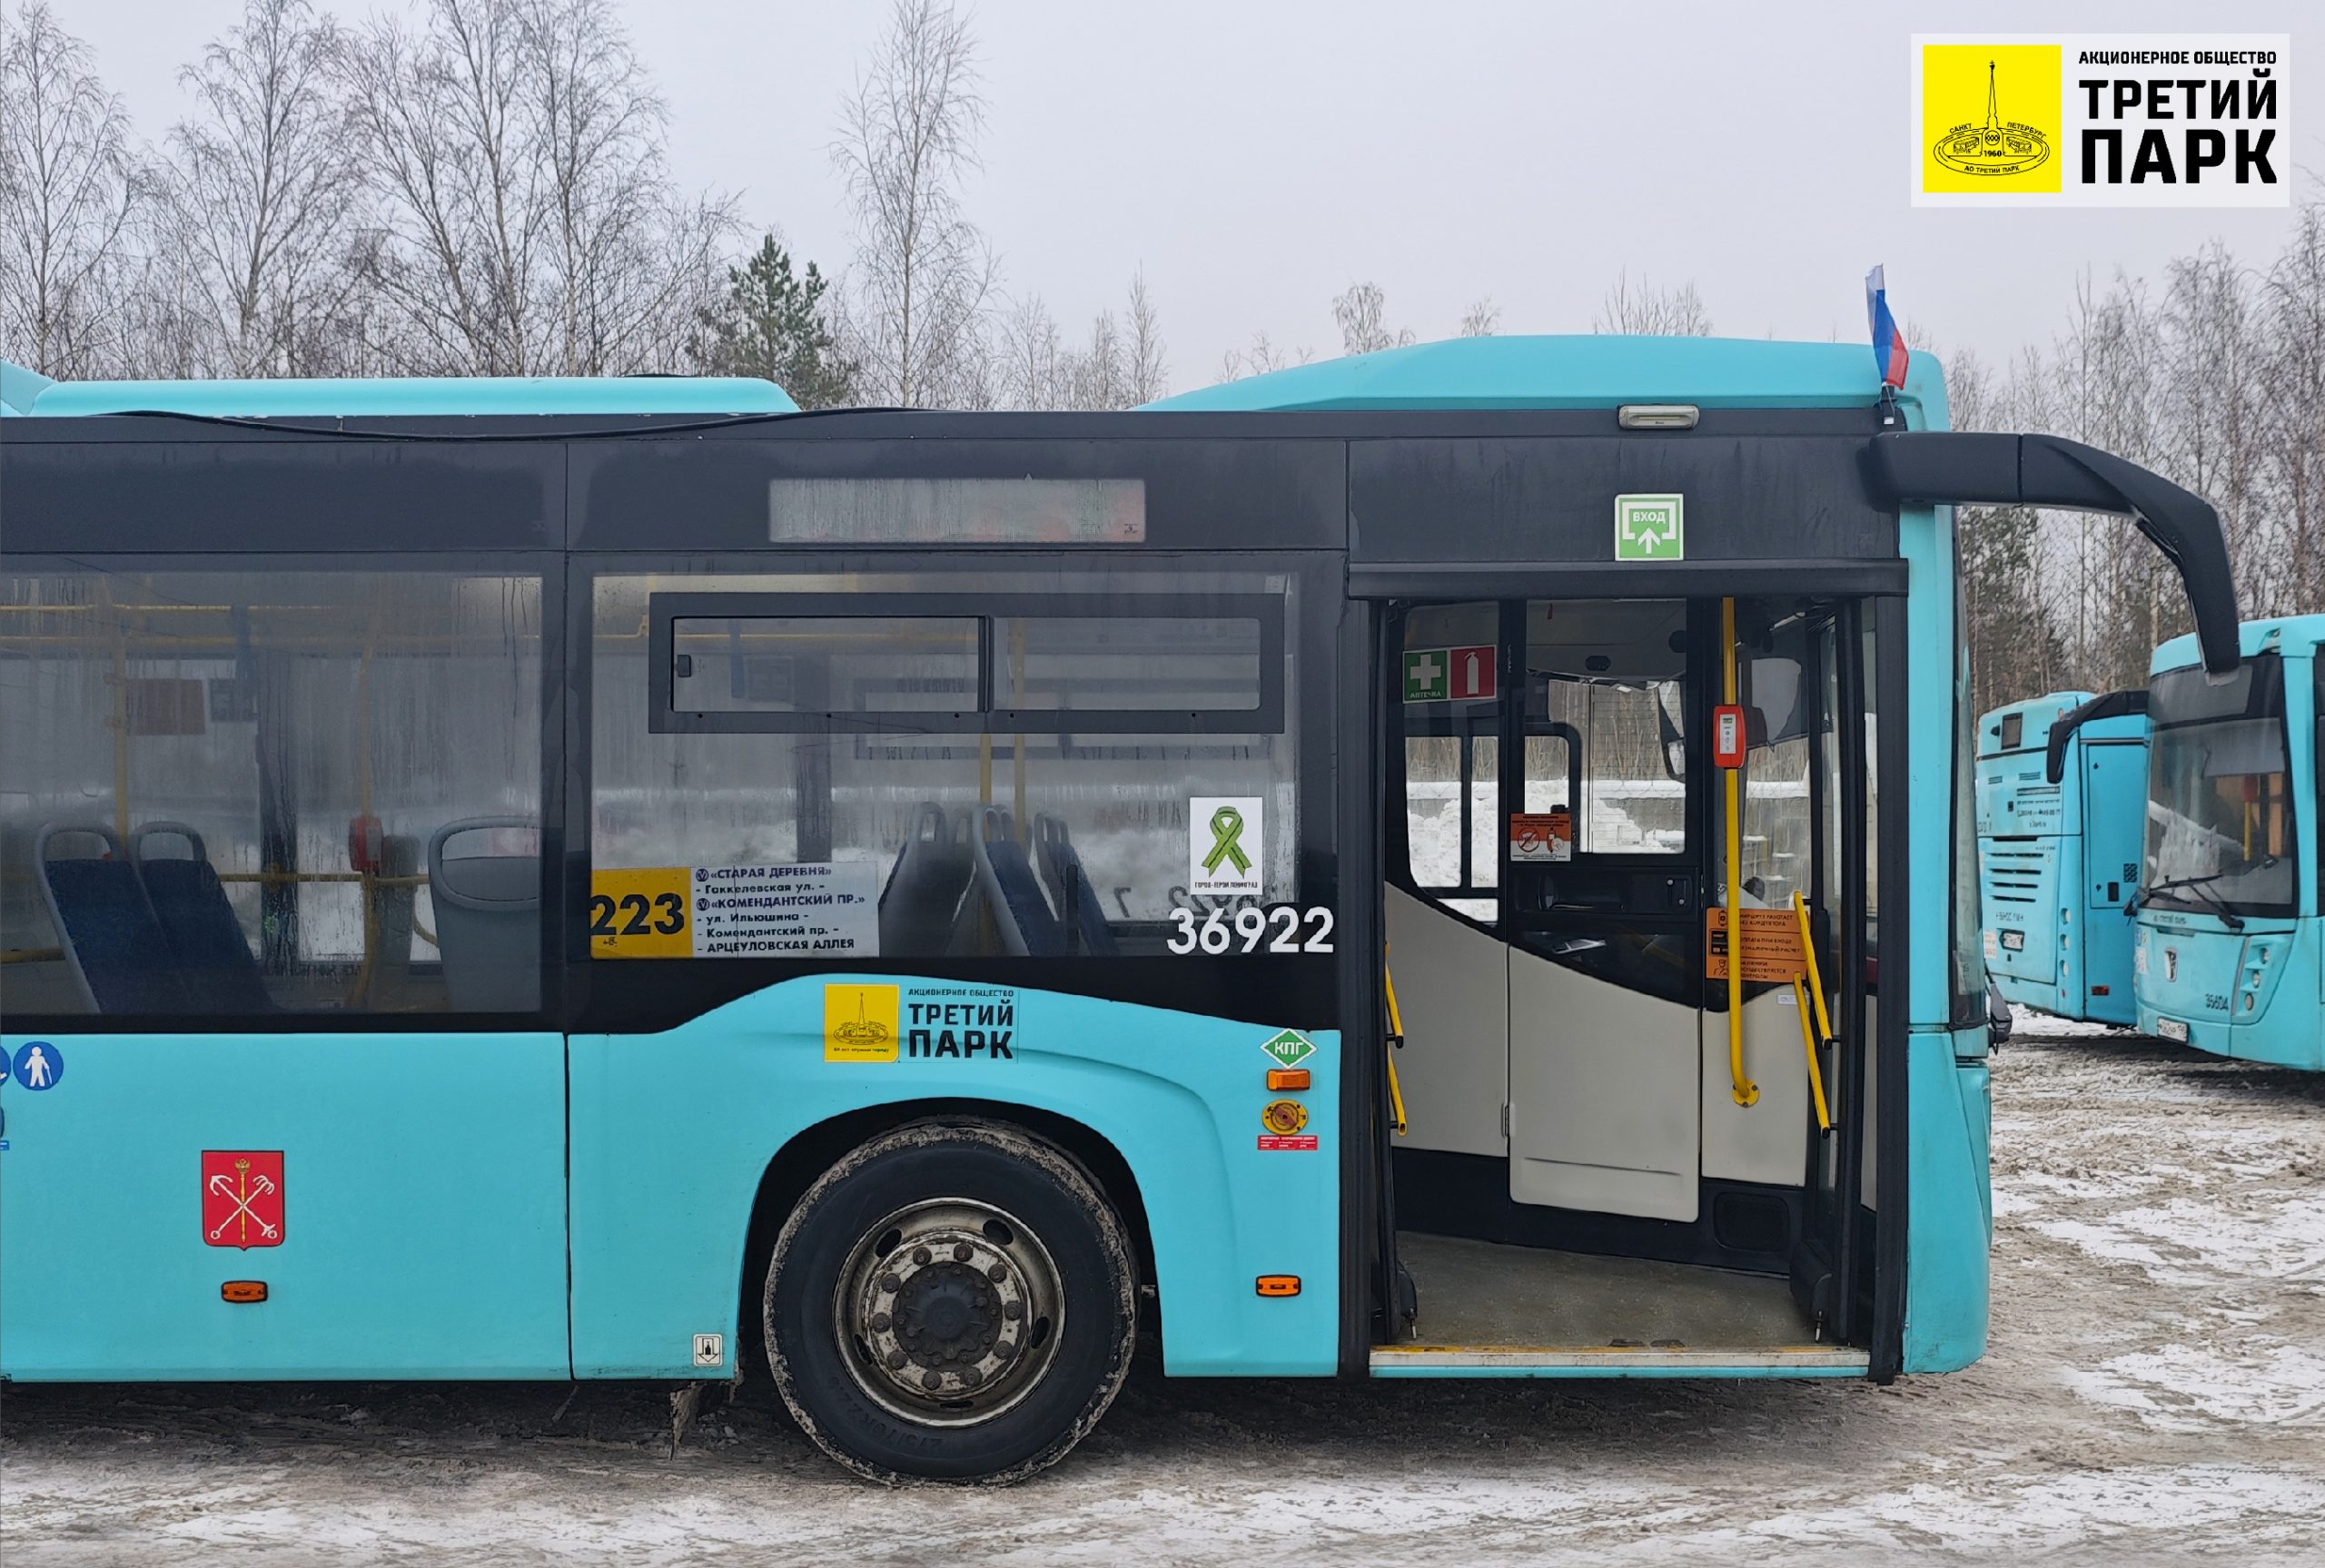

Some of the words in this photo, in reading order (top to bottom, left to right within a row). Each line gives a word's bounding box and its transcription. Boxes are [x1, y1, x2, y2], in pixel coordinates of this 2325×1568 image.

[1632, 511, 1666, 524] ВХОД
[711, 868, 765, 879] «СТАРАЯ
[769, 866, 832, 878] ДЕРЕВНЯ»
[706, 884, 791, 894] Гаккелевская
[796, 883, 815, 893] ул.
[711, 893, 833, 909] «КОМЕНДАНТСКИЙ
[837, 894, 866, 904] ПР.»
[589, 892, 685, 936] 223
[706, 915, 726, 926] ул.
[730, 913, 799, 922] Ильюшина
[707, 926, 806, 939] Комендантский
[809, 927, 828, 936] пр.
[1166, 906, 1334, 955] 36922
[707, 940, 808, 954] АРЦЕУЛОВСКАЯ
[813, 939, 855, 950] АЛЛЕЯ
[908, 988, 966, 997] АКЦИОНЕРНОЕ
[969, 989, 1014, 998] ОБЩЕСТВО
[908, 999, 1014, 1026] ТРЕТИЙ
[909, 1029, 1014, 1060] ПАРК
[1274, 1041, 1304, 1055] КПГ
